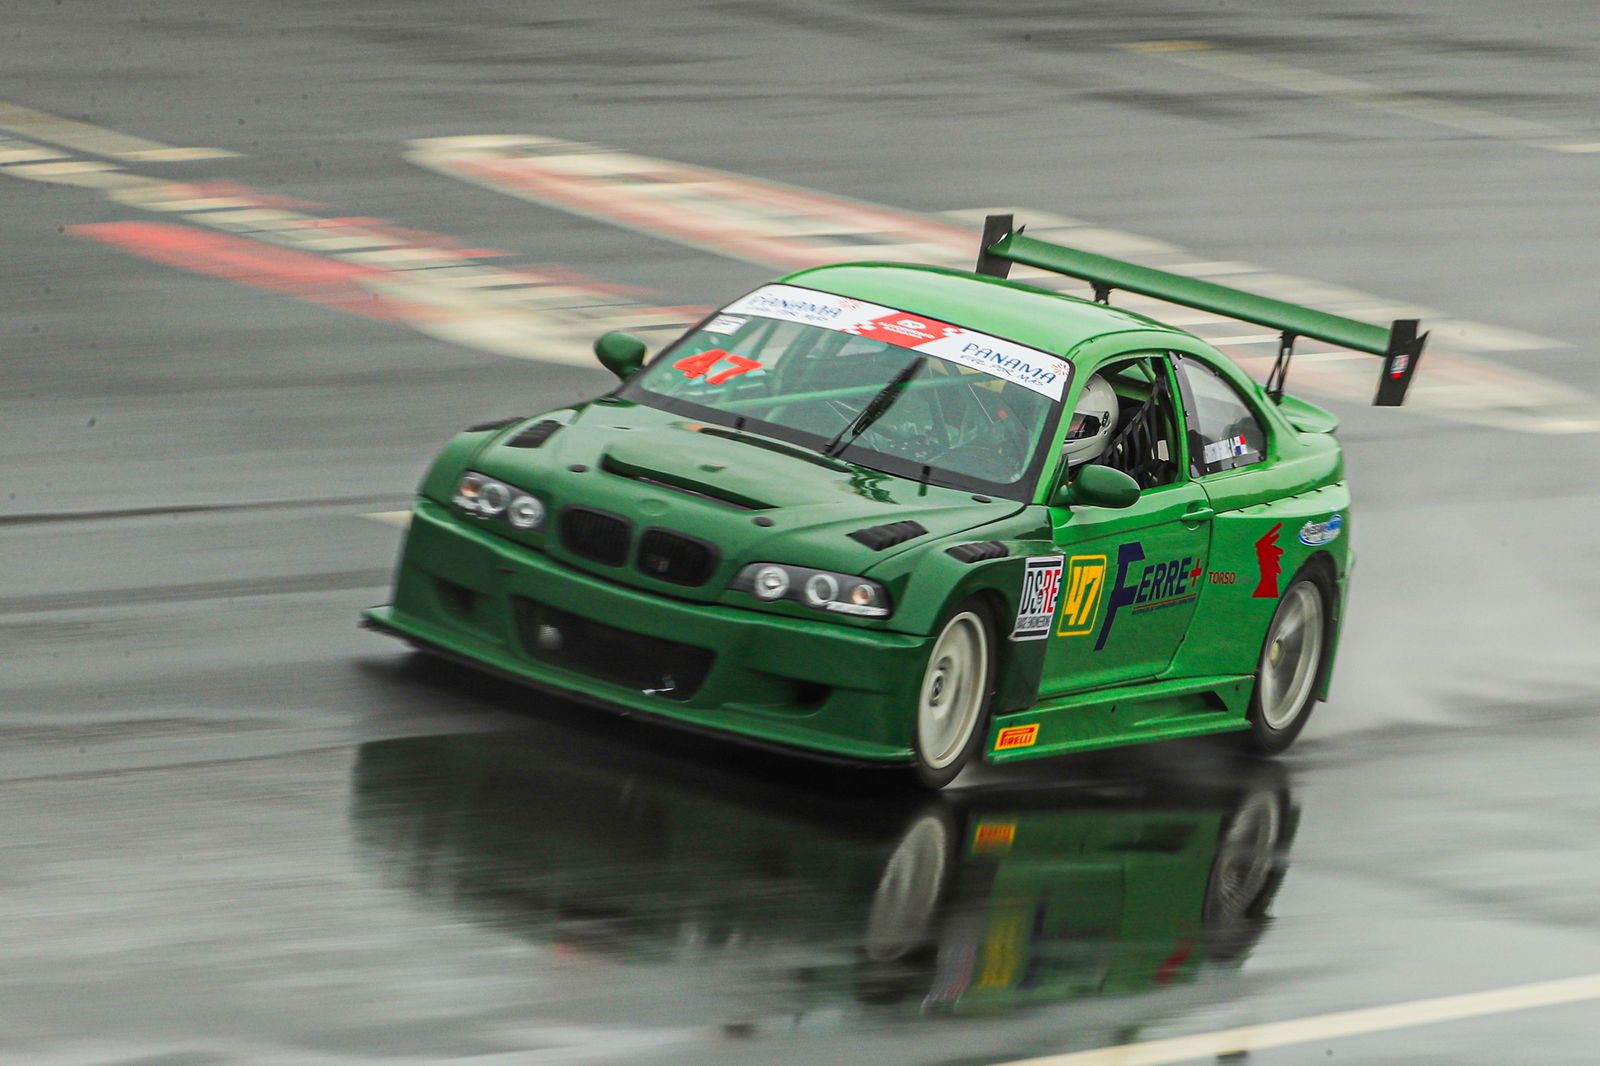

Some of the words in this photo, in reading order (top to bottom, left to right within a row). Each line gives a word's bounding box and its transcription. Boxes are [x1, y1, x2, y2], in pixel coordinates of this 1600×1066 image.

[672, 348, 763, 385] 47
[962, 343, 1056, 383] PANAMA
[1065, 565, 1104, 626] 47
[1208, 571, 1235, 585] TORSO
